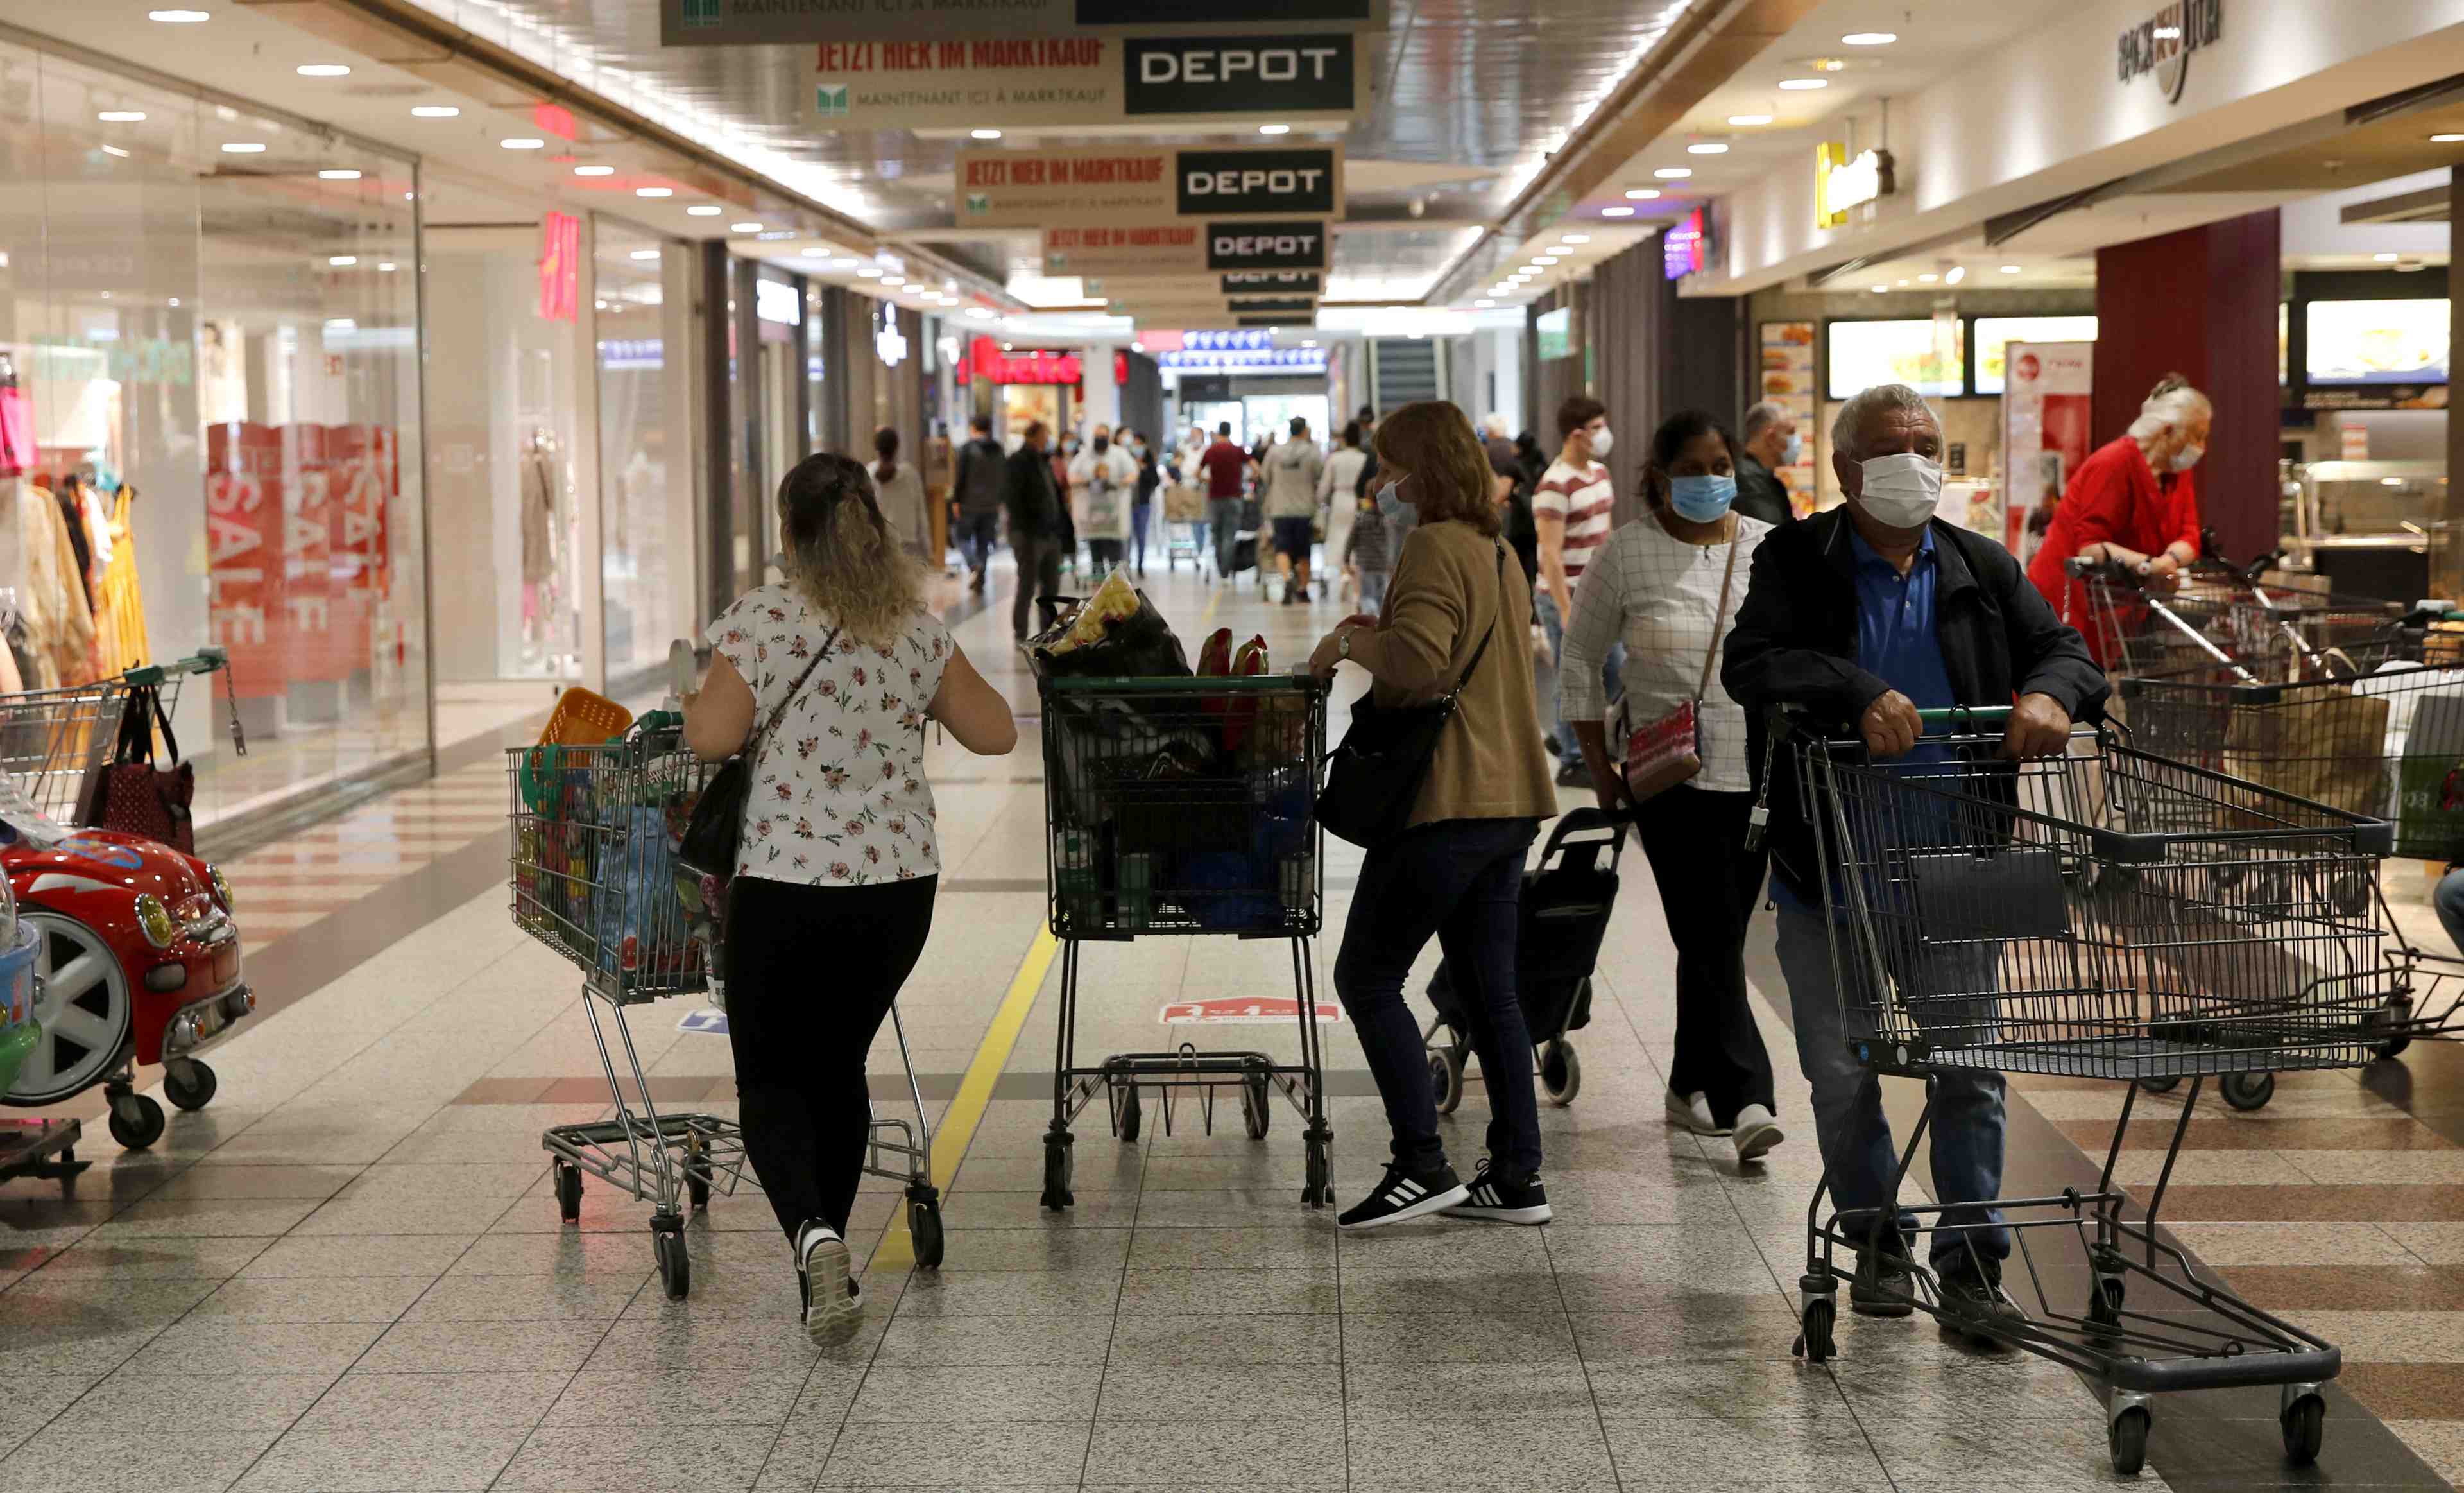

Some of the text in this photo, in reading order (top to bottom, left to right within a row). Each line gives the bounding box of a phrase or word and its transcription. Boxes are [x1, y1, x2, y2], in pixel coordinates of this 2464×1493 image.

[816, 38, 1105, 72] JETZT HIER IM MARKTKAUF
[1140, 48, 1337, 83] DEPOT
[857, 91, 961, 105] MAINTENANT
[1013, 87, 1106, 103] MARKTKAUF
[1072, 157, 1163, 183] MARKTKAUF
[1187, 169, 1323, 195] DEPOT
[1214, 236, 1316, 255] DEPOT
[209, 472, 266, 644] SALE
